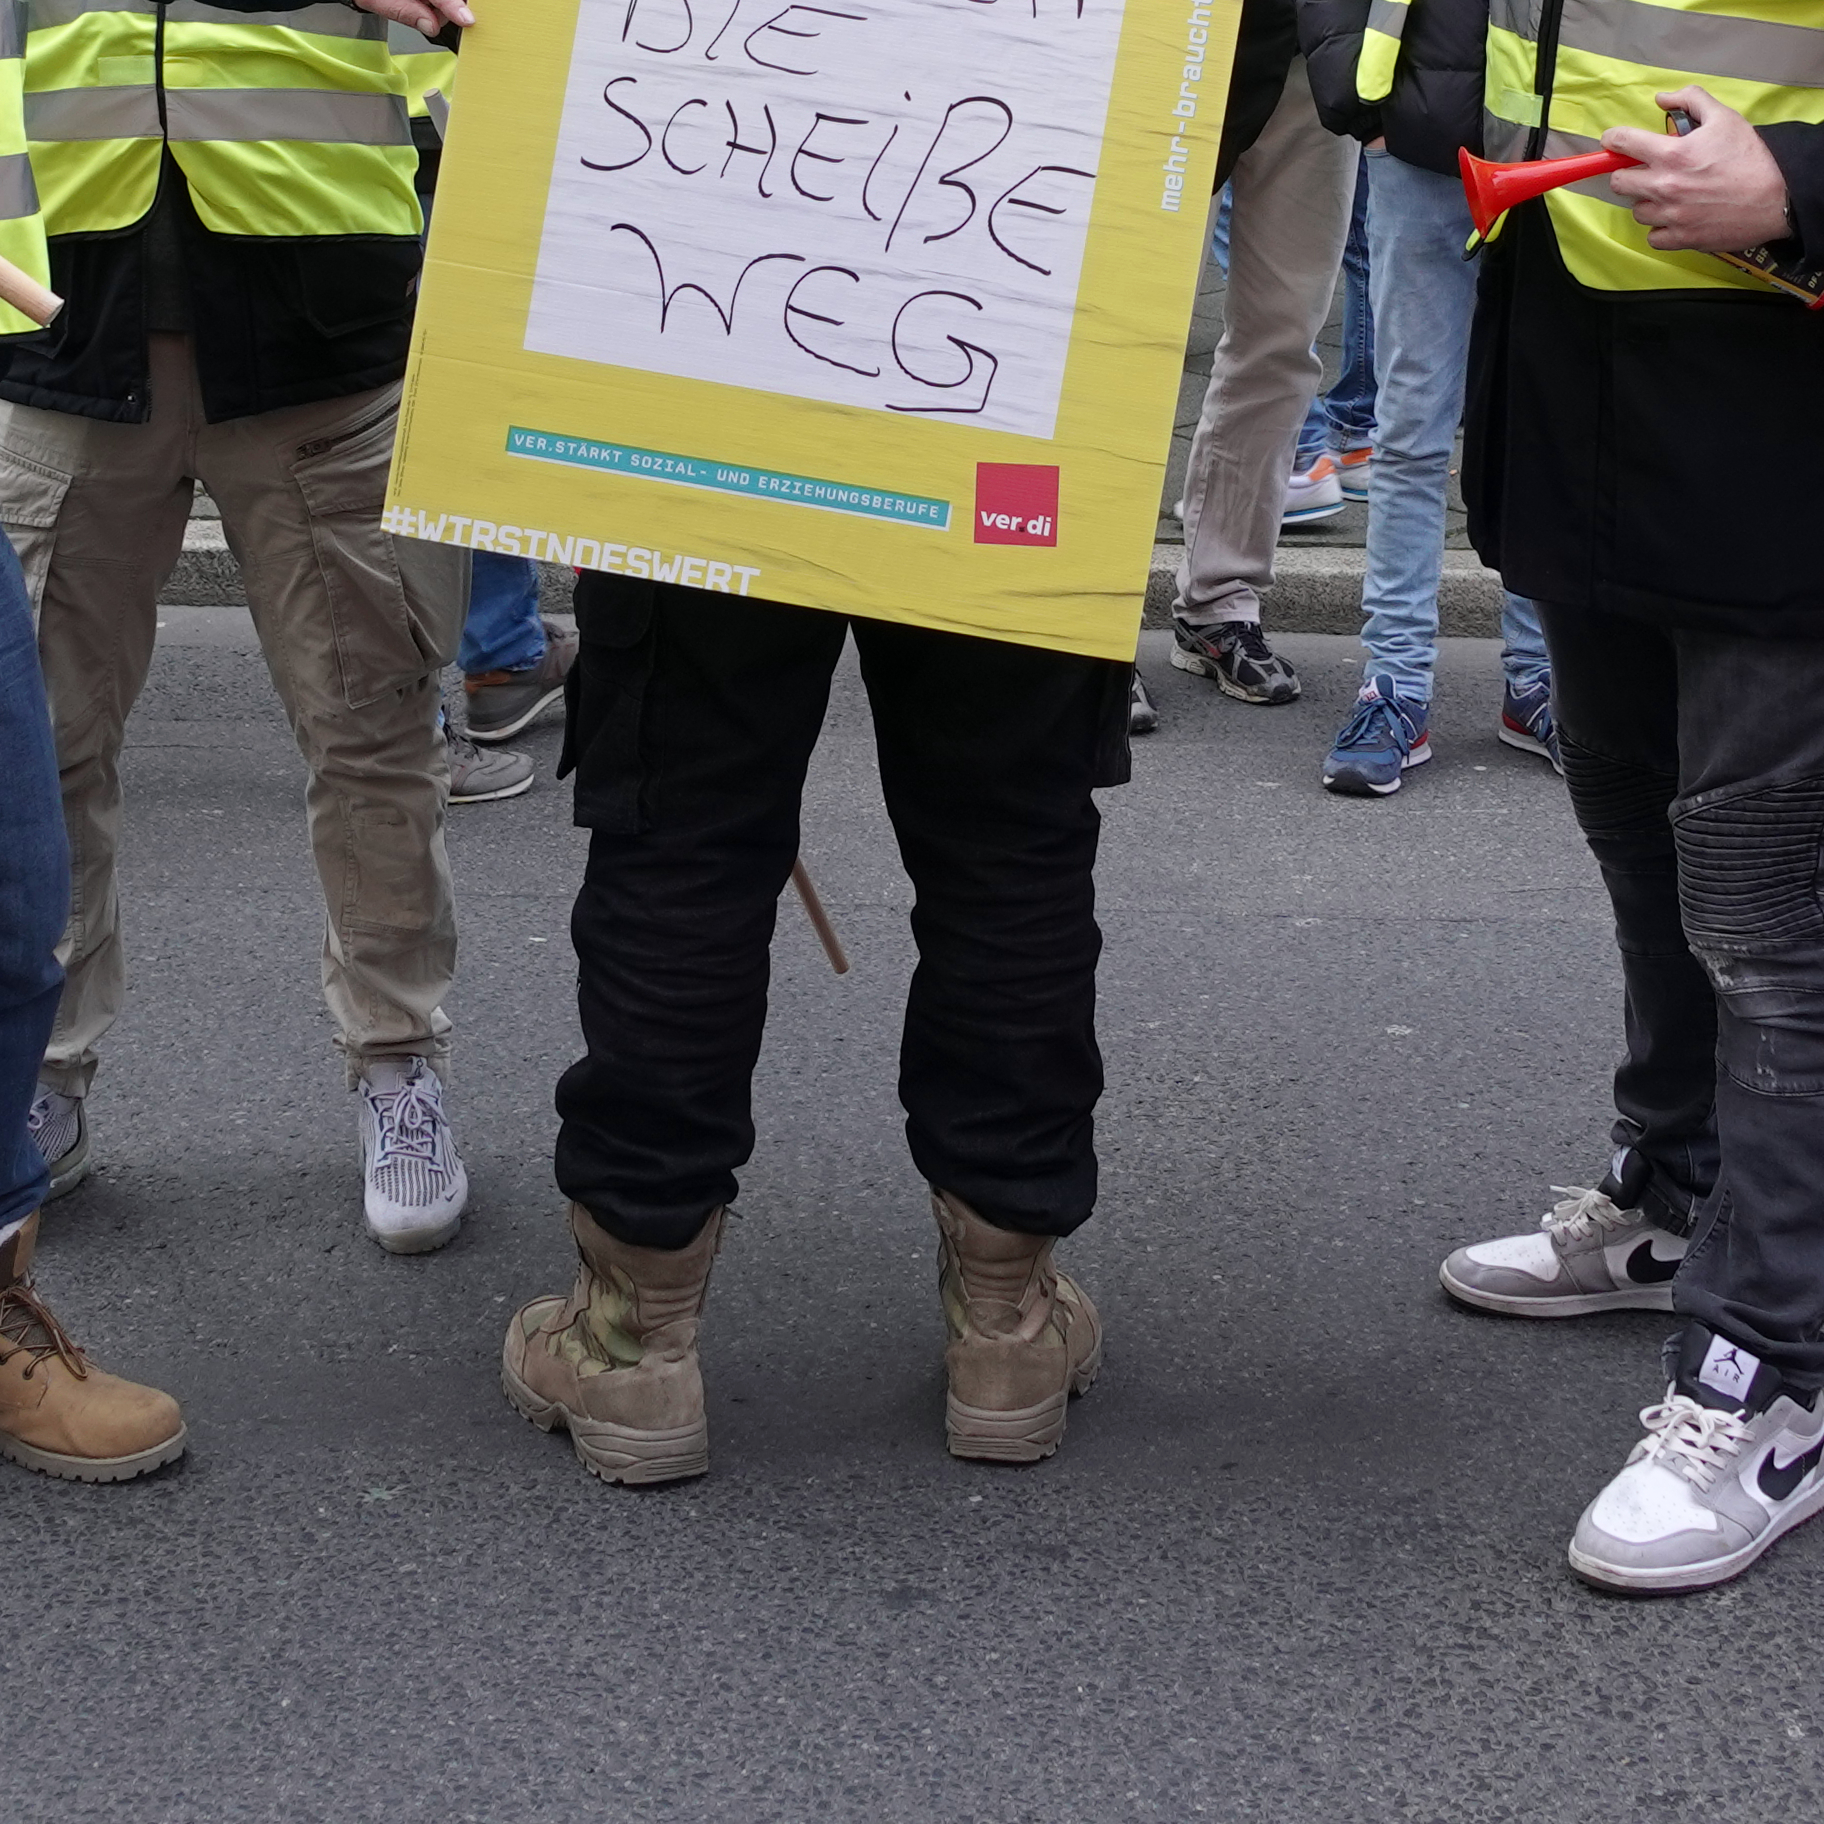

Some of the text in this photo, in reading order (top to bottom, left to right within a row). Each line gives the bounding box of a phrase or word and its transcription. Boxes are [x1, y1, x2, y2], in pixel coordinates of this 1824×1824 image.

[610, 222, 999, 414] WEG
[514, 433, 623, 465] VER.STÄRKT
[716, 468, 750, 486] UND
[758, 476, 940, 520] ERZIEHUNGSBERUFE
[382, 505, 762, 597] #WIRSINDESWERT
[979, 510, 1052, 538] ver.di
[1712, 1363, 1740, 1384] AIR
